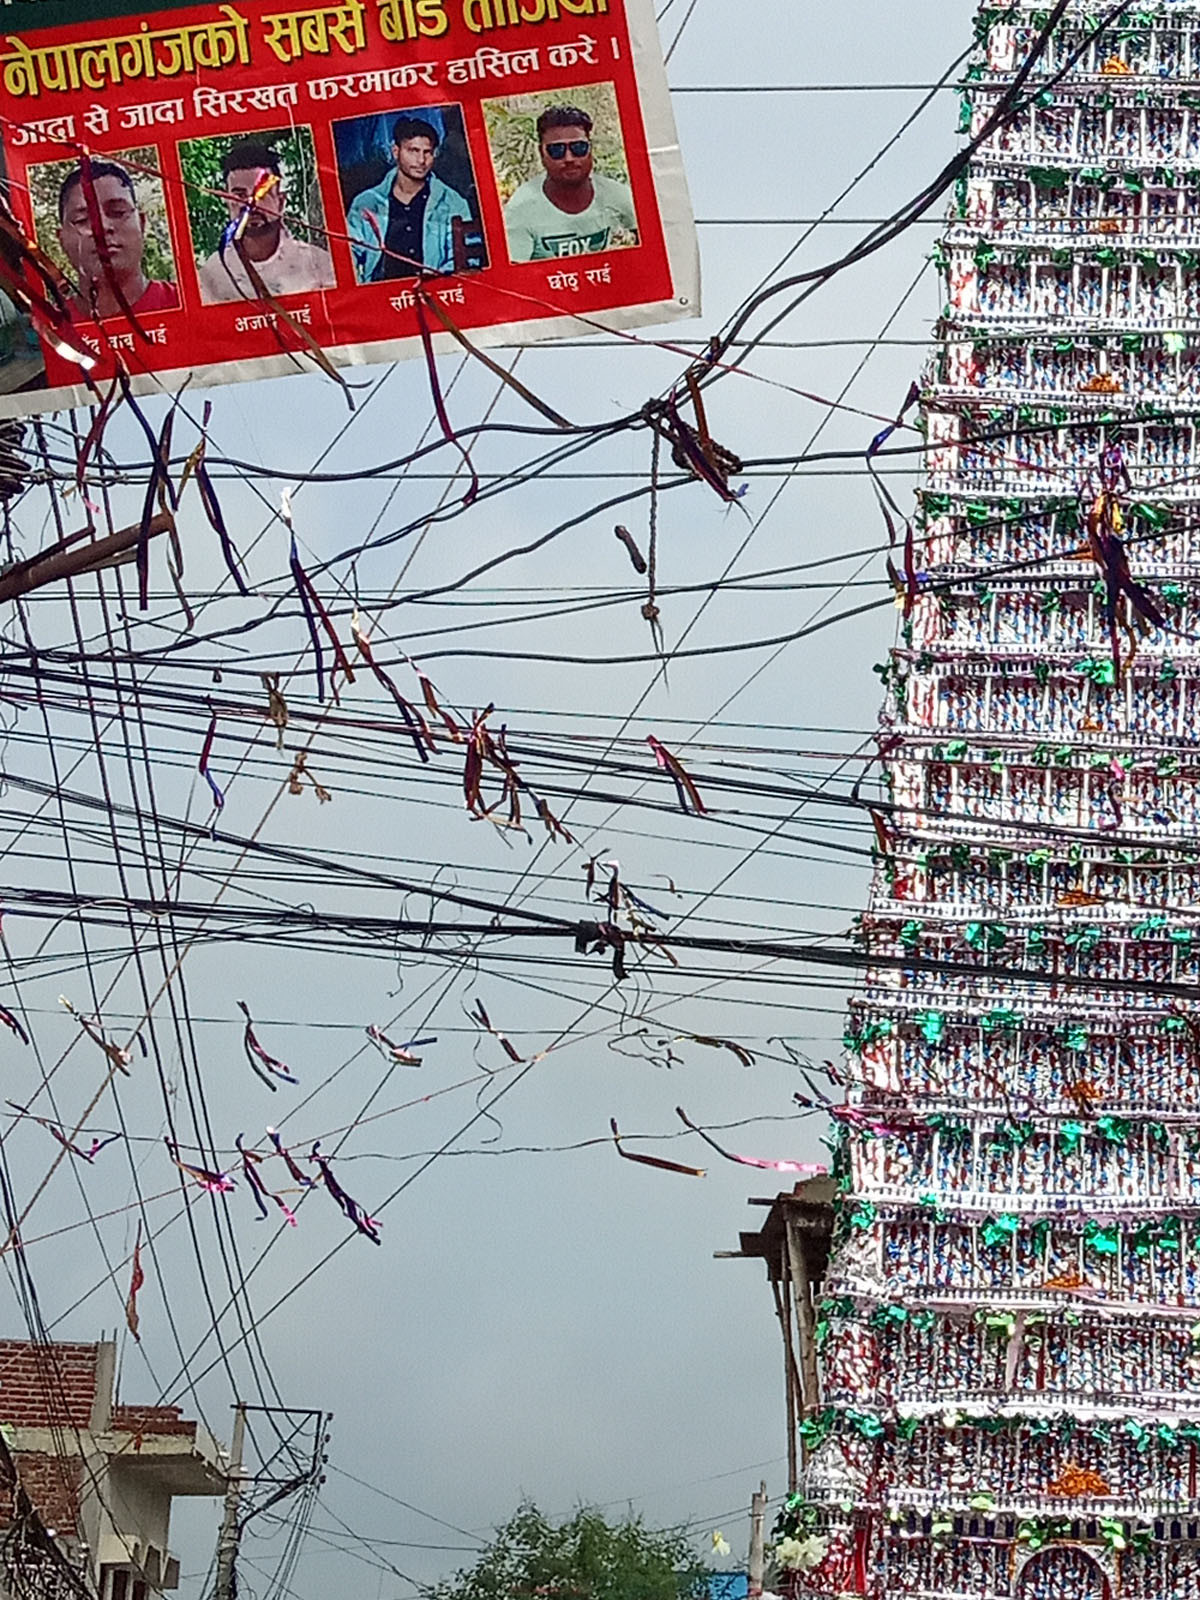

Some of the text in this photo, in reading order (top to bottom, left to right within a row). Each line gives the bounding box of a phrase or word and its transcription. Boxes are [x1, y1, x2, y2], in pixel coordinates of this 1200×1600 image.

[0, 5, 250, 97] नेपालगंजको
[83, 103, 110, 136] से
[118, 97, 185, 128] जादा
[306, 61, 440, 101] फरमाकर
[446, 46, 540, 85] हासिल
[547, 33, 599, 68] करे
[558, 236, 592, 258] FOX
